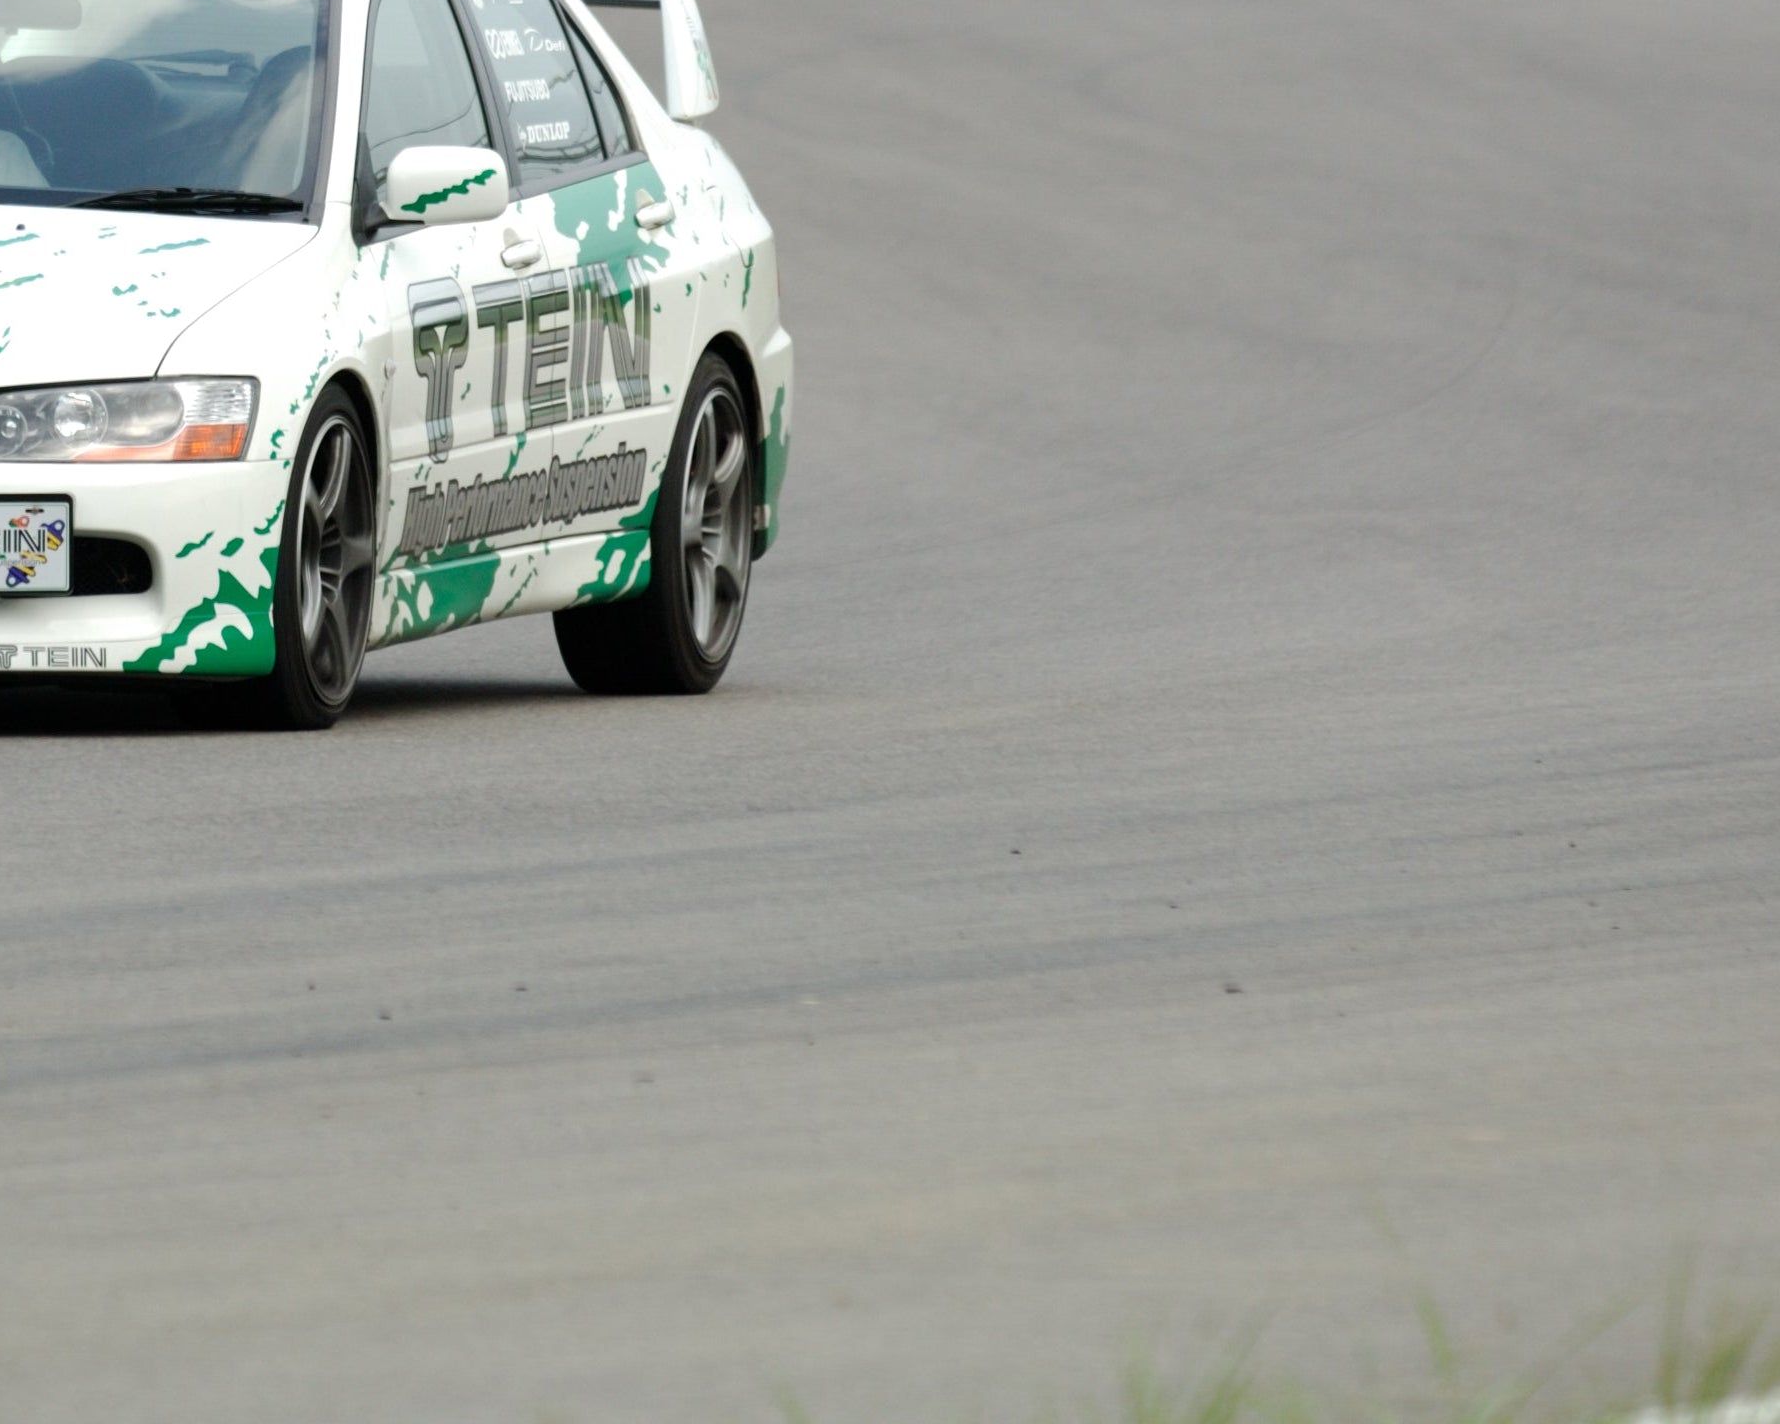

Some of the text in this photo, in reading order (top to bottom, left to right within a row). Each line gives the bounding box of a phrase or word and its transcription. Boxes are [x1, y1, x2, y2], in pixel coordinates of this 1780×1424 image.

[544, 38, 566, 52] Defi
[504, 79, 550, 103] FUJITSUBO
[526, 121, 570, 143] DUNLOP
[472, 256, 652, 438] TEIN
[436, 468, 547, 549] Performance
[542, 441, 647, 526] Suspension
[23, 646, 107, 668] TEIN
